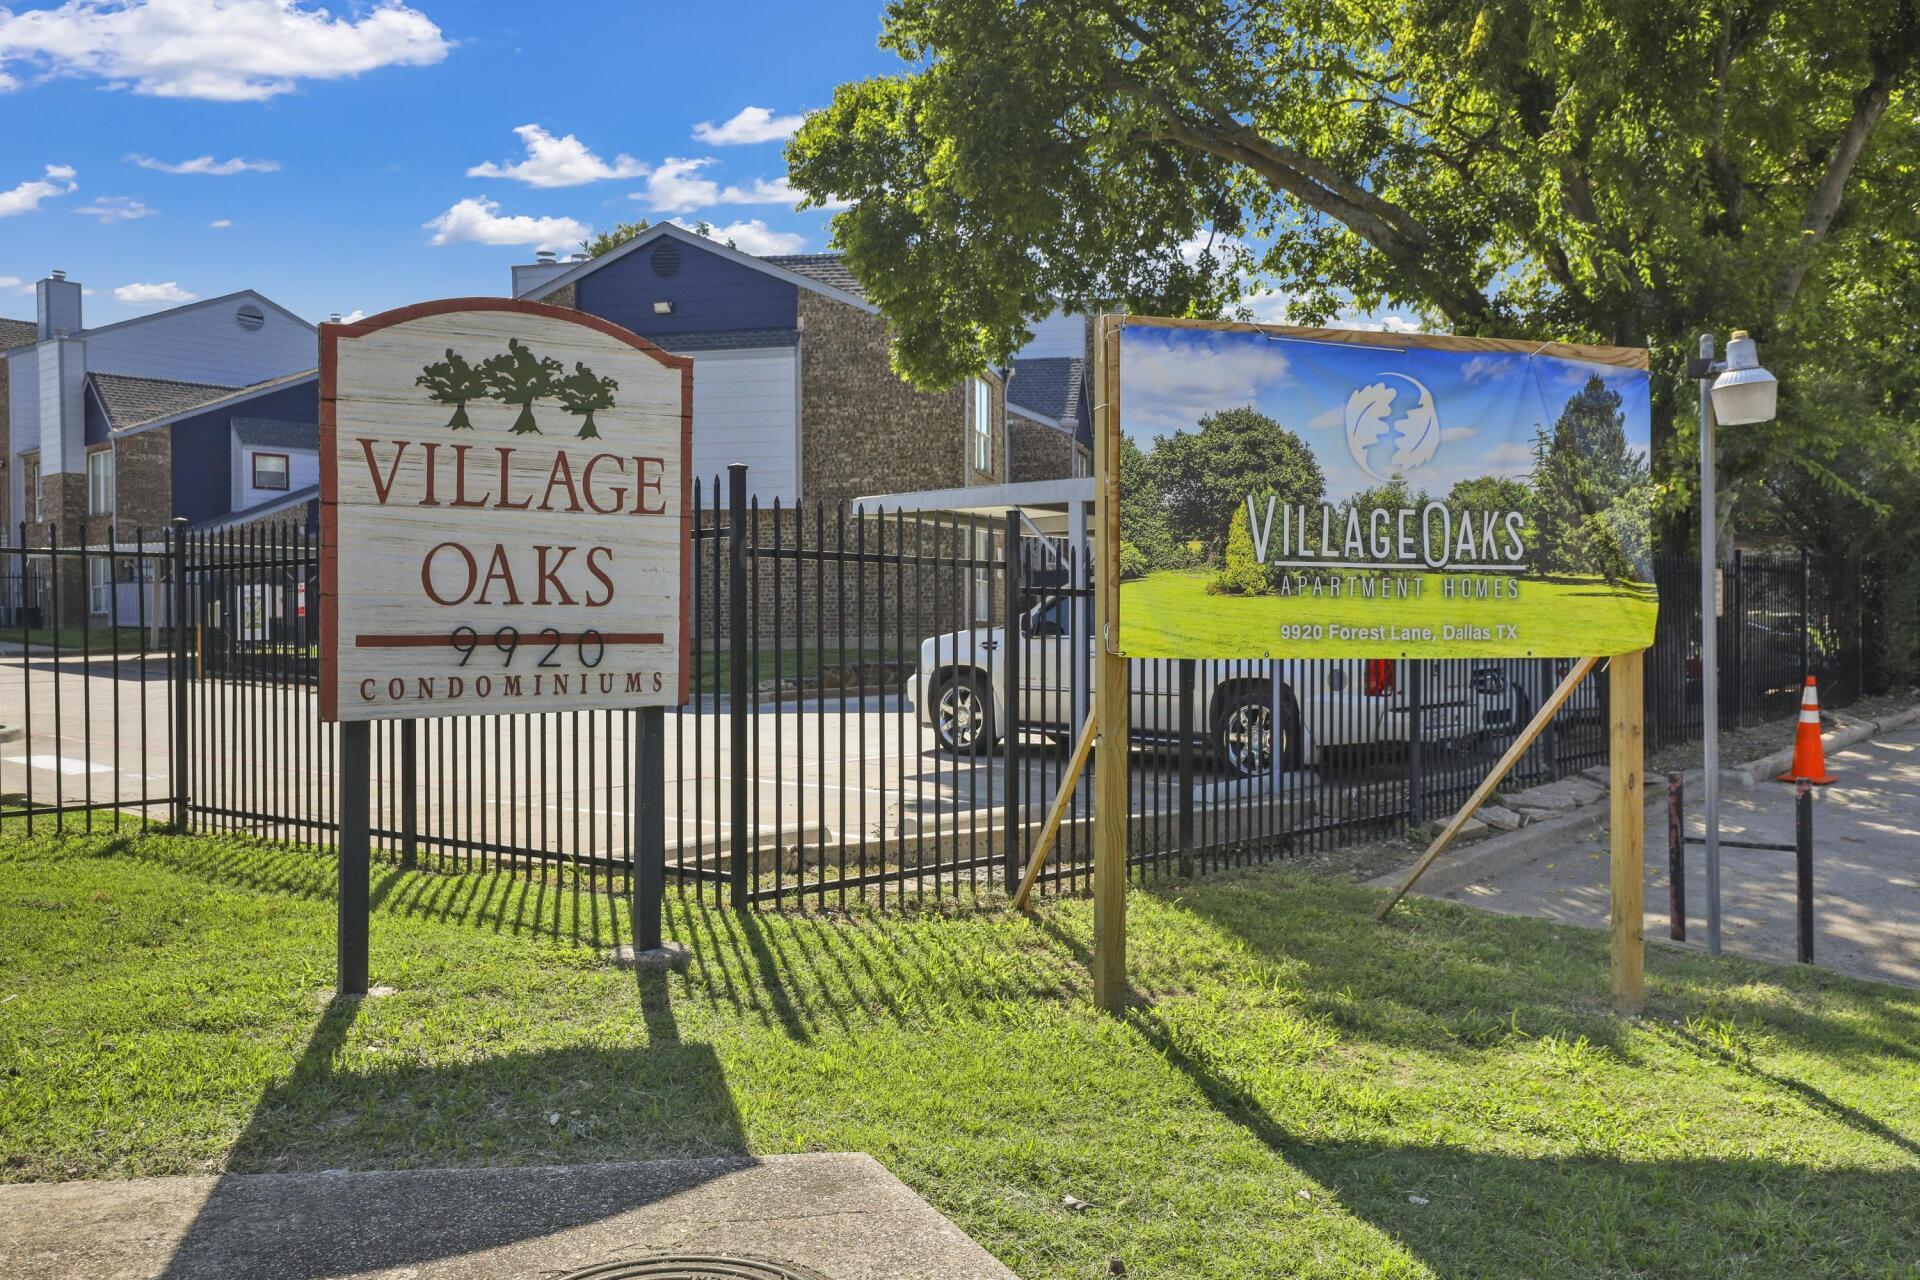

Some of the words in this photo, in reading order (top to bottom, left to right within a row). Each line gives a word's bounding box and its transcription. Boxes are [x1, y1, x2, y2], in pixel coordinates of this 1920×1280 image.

[355, 438, 667, 515] VILLAGE
[421, 541, 615, 607] OAKS
[1281, 575, 1424, 598] APARTMENT
[1444, 577, 1519, 599] HOMES
[450, 625, 605, 669] 9920
[1280, 624, 1323, 640] 9920
[1329, 624, 1386, 641] Forest
[1391, 625, 1437, 642] Lane,
[1442, 624, 1491, 641] Dallas
[1496, 624, 1518, 640] TX
[359, 672, 663, 701] CONDOMINIUMS
